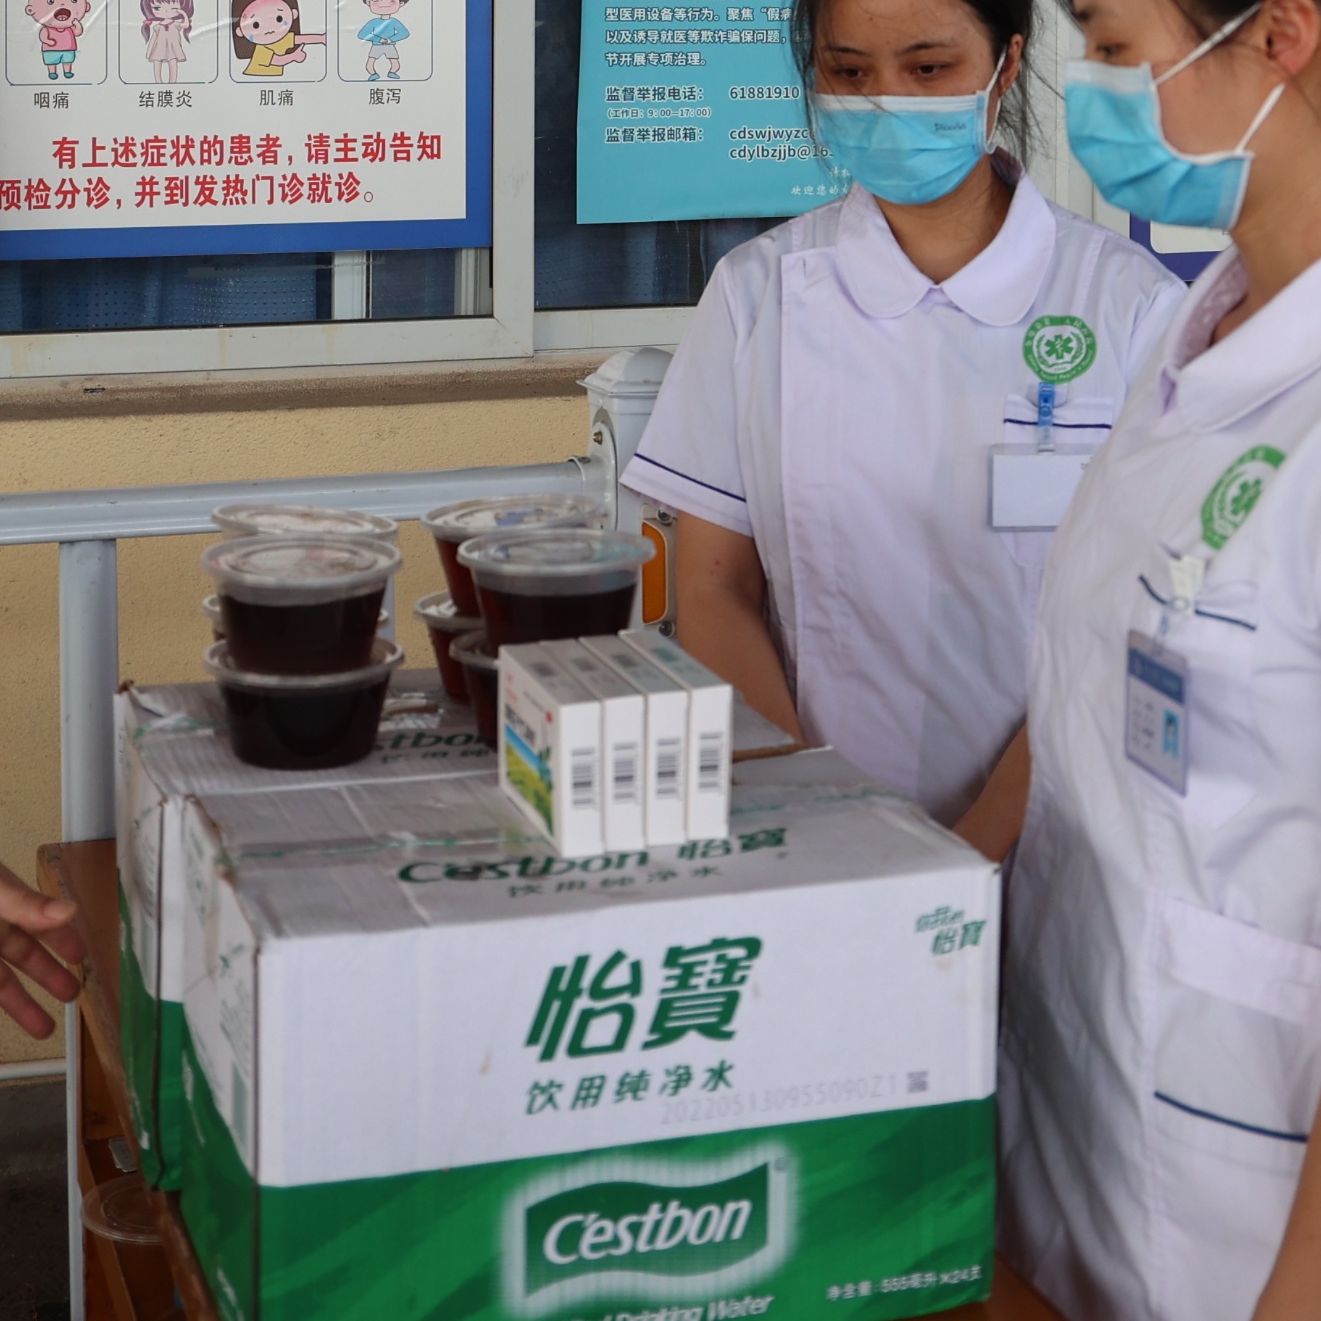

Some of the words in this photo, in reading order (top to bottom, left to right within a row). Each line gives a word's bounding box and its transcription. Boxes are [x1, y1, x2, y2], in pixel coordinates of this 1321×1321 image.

[605, 52, 706, 67] 节开展专项治理。
[33, 91, 70, 110] 咽痛
[138, 90, 193, 108] 结膜炎
[259, 89, 294, 107] 肌痛
[368, 87, 401, 105] 腹泻
[605, 86, 704, 102] 监督举报电话：
[729, 86, 800, 100] 61881910
[605, 127, 704, 144] 监督举报邮箱：
[51, 131, 443, 170] 有上述症状的患者，请主动告知
[524, 936, 764, 1063] 怡寶
[525, 1060, 735, 1115] 饮用纯净水
[707, 1294, 774, 1321] Water
